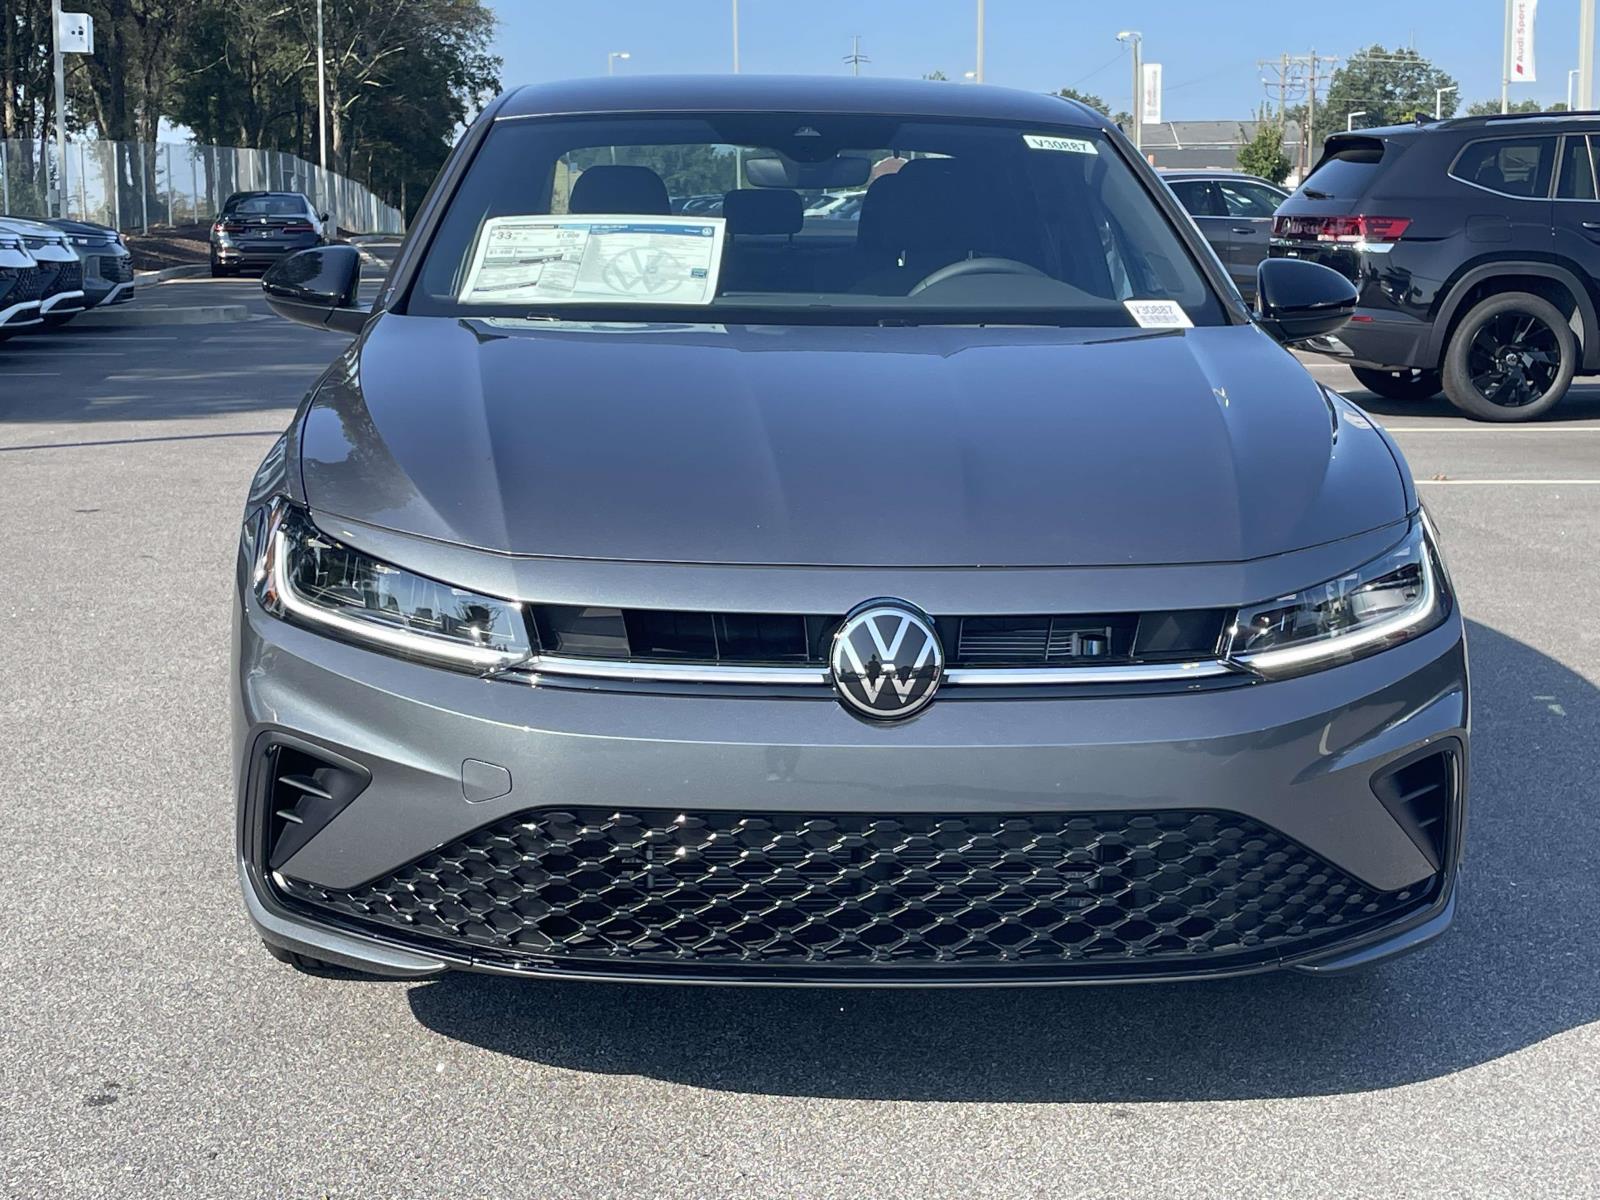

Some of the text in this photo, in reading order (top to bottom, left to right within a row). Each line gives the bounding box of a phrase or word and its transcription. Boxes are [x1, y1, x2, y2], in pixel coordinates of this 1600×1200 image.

[1516, 2, 1526, 63] Audi Sport
[1032, 138, 1087, 152] V30887
[496, 231, 513, 240] 33
